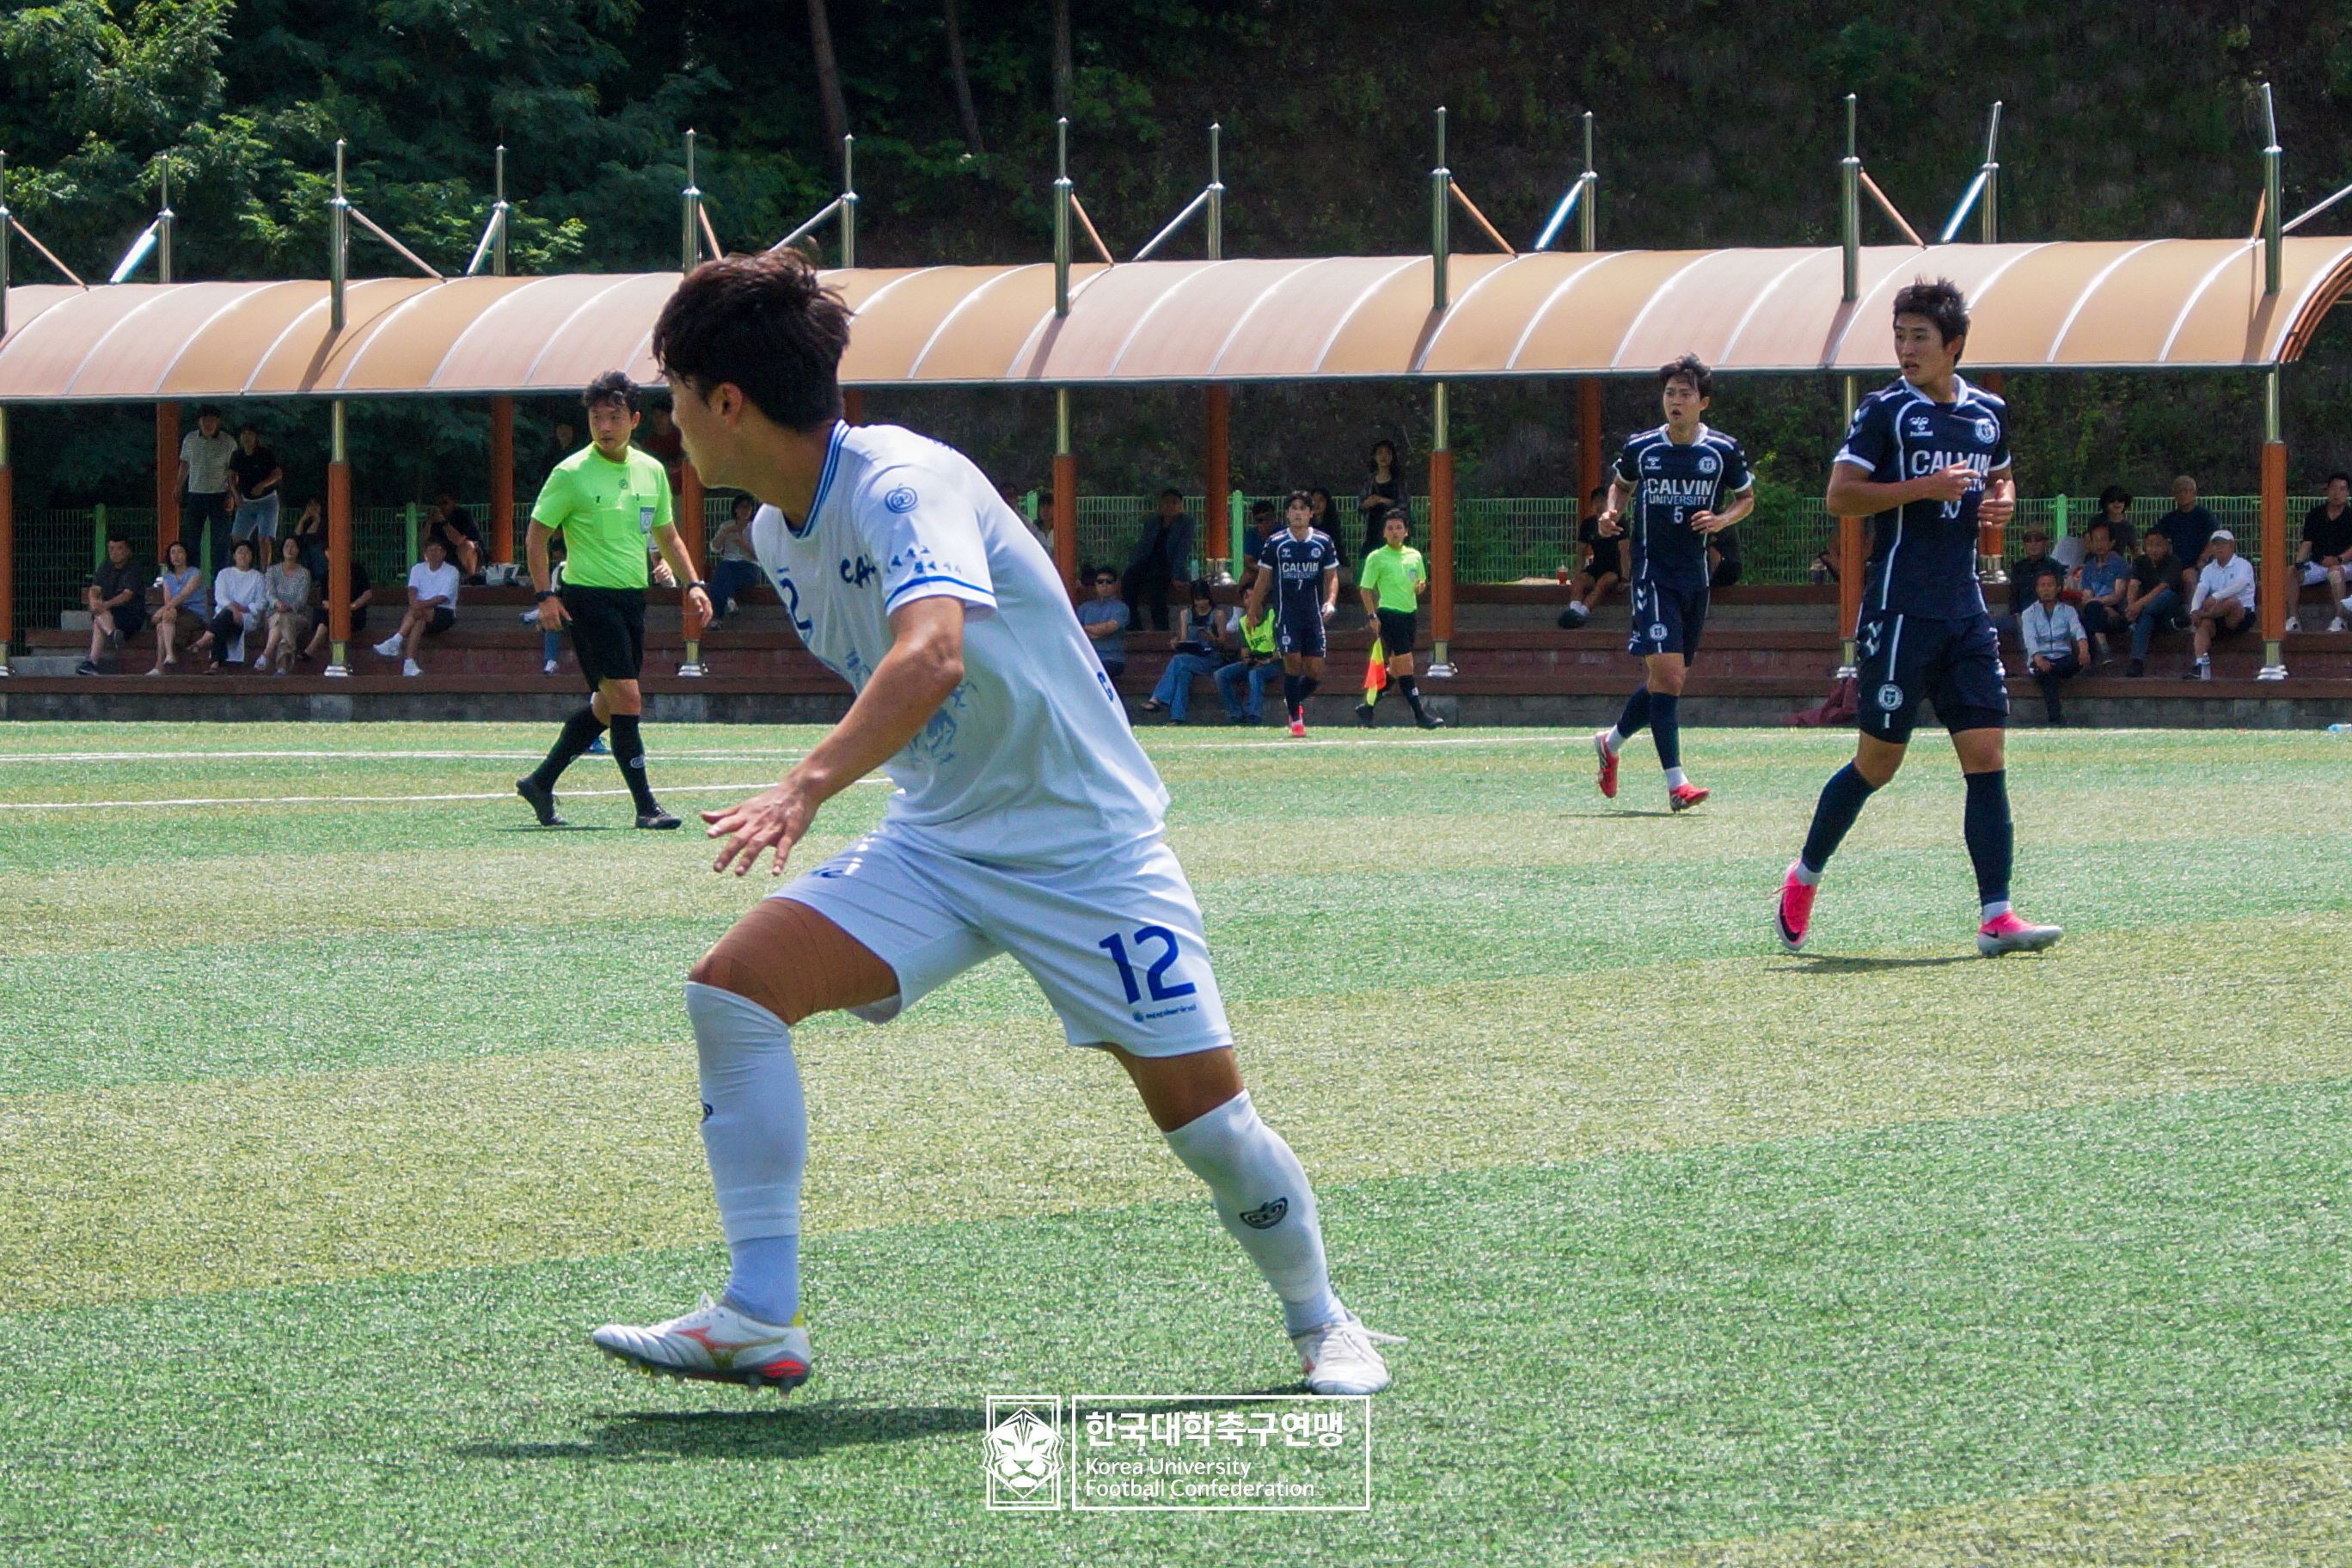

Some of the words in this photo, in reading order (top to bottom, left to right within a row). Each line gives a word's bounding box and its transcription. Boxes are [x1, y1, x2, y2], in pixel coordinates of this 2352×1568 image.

[1647, 478, 1713, 495] CALVIN
[1649, 494, 1708, 505] UNIVERSITY
[1674, 505, 1684, 524] 5
[1282, 561, 1319, 573] CALVIN
[1297, 579, 1303, 591] 7
[1099, 926, 1197, 1005] 12
